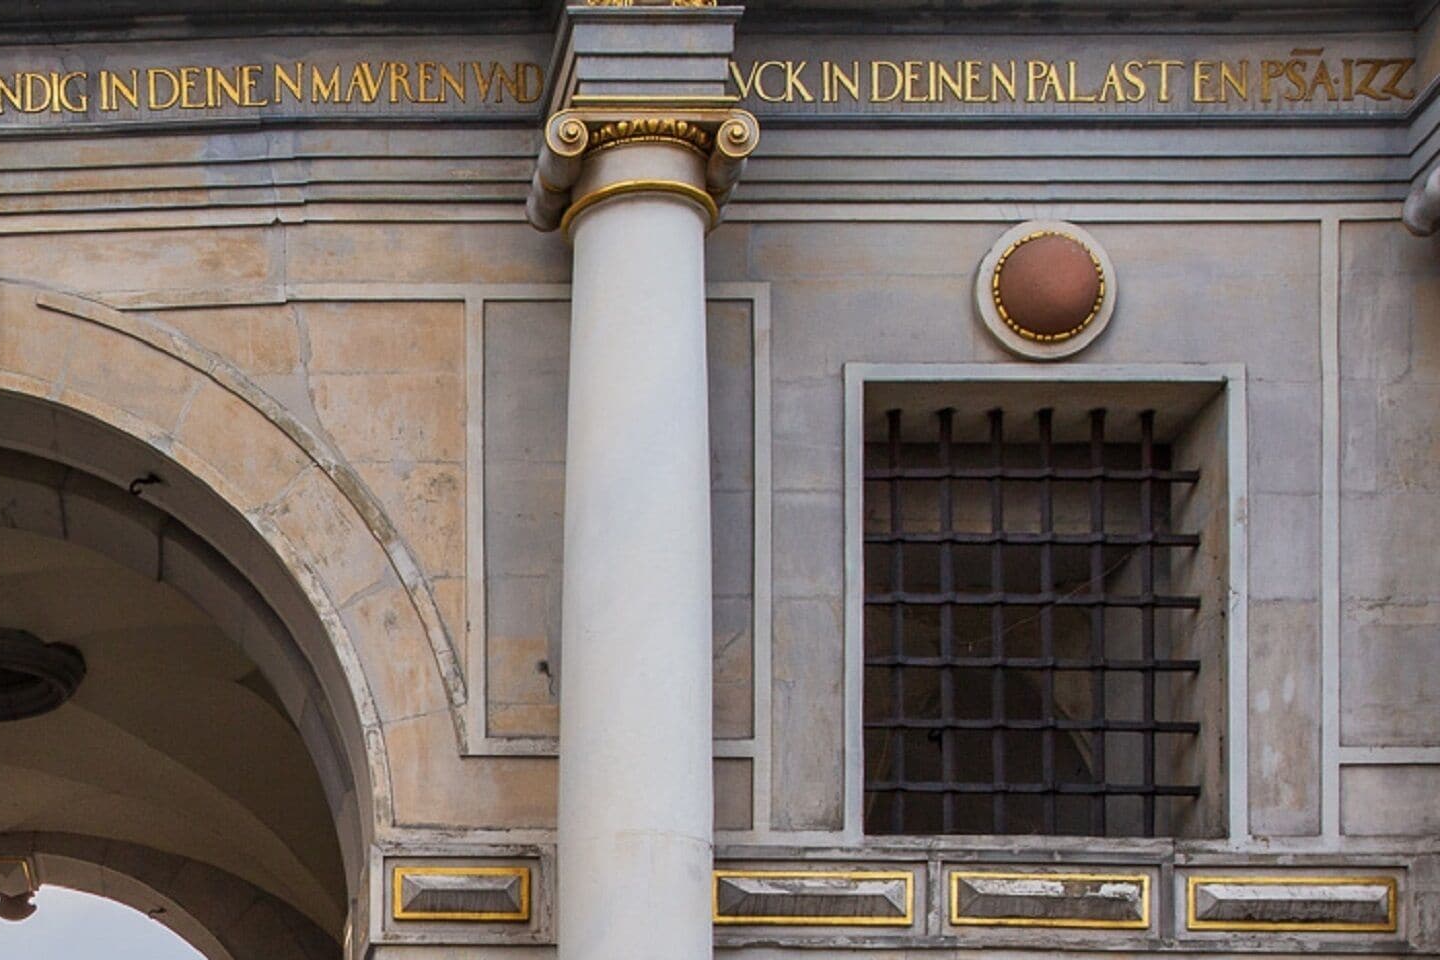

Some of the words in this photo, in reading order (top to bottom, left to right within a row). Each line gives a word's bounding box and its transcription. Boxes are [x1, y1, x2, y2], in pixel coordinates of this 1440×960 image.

[100, 70, 140, 111] IN
[471, 61, 545, 103] VND
[822, 60, 860, 102] IN
[870, 60, 1017, 102] DEINEN
